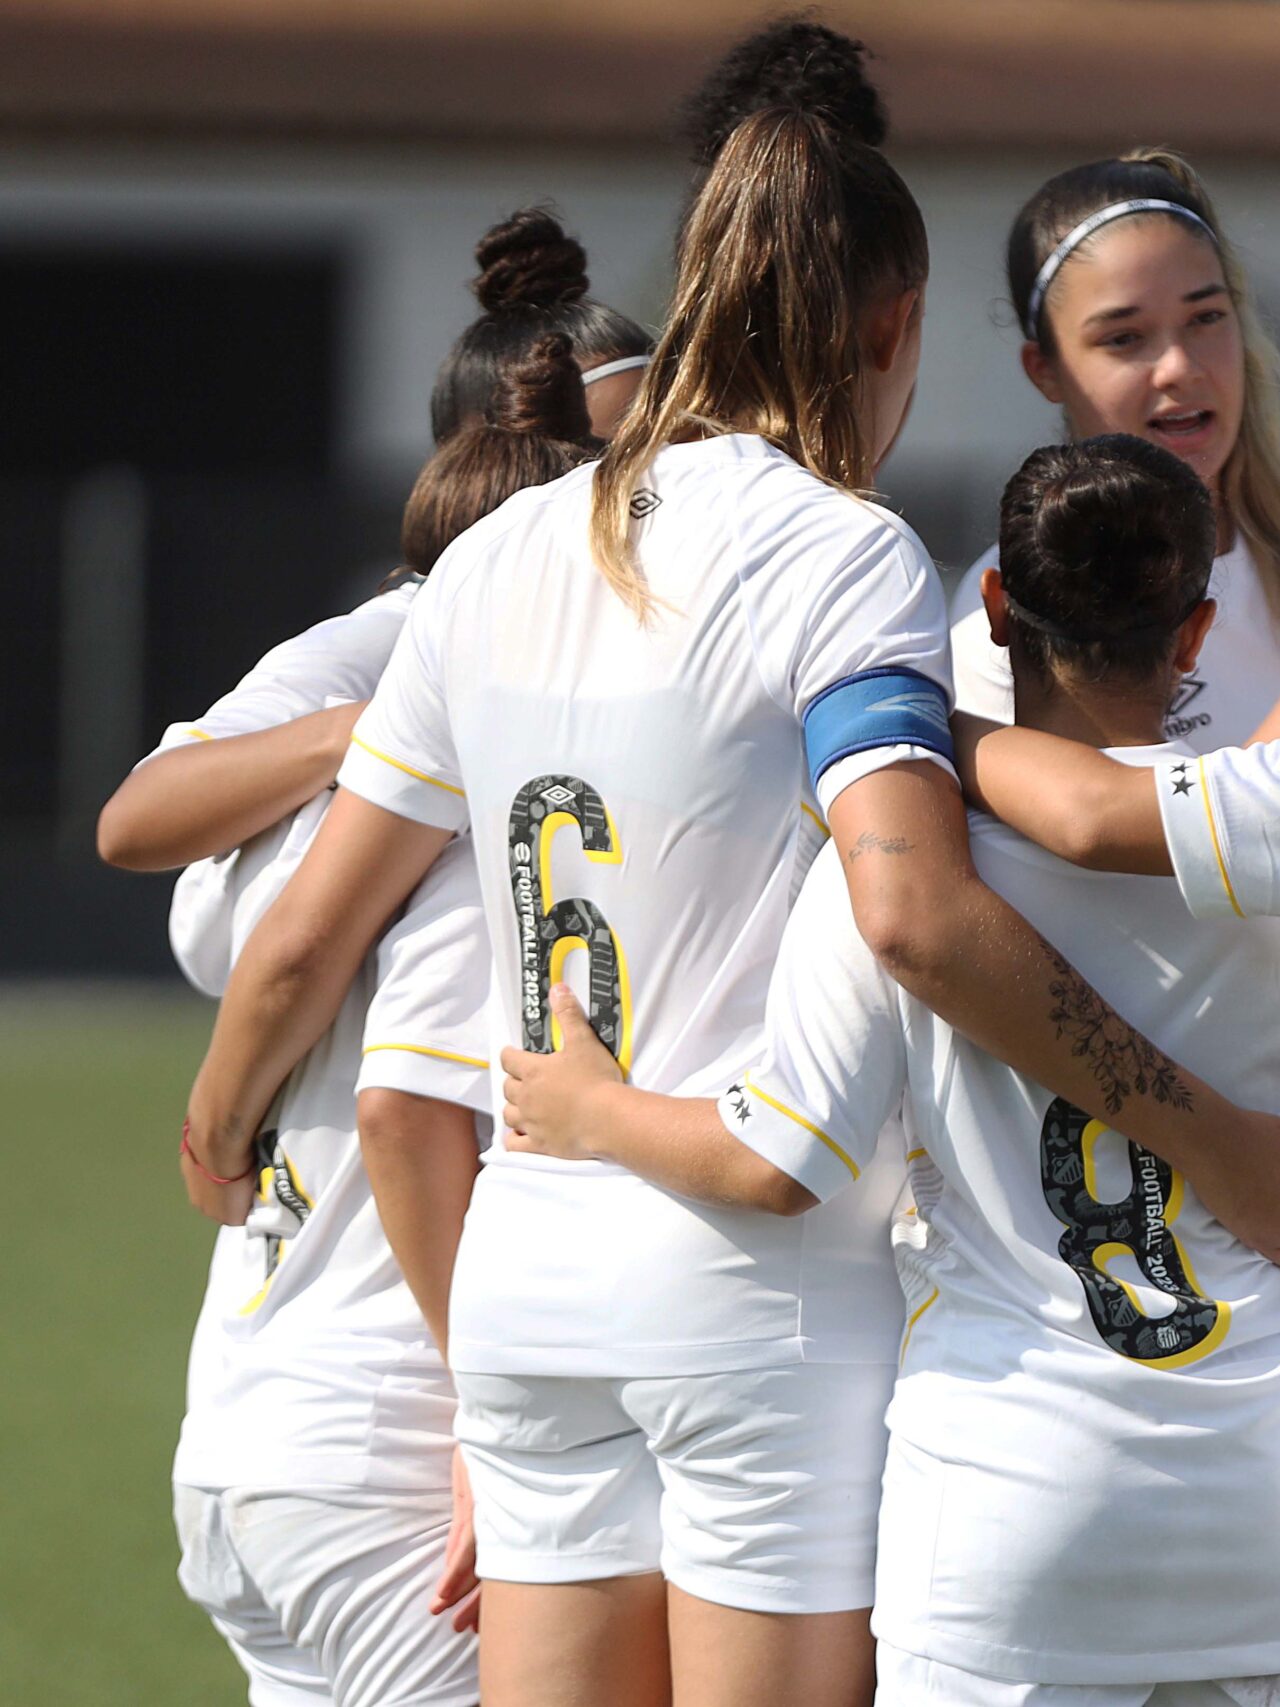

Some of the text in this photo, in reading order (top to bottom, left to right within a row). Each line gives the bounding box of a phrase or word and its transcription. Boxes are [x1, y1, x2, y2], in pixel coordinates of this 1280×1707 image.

[1165, 713, 1212, 736] mbro
[508, 774, 632, 1082] 6
[524, 969, 541, 1020] 2023
[1040, 1096, 1232, 1370] 8
[1146, 1253, 1181, 1292] 2023
